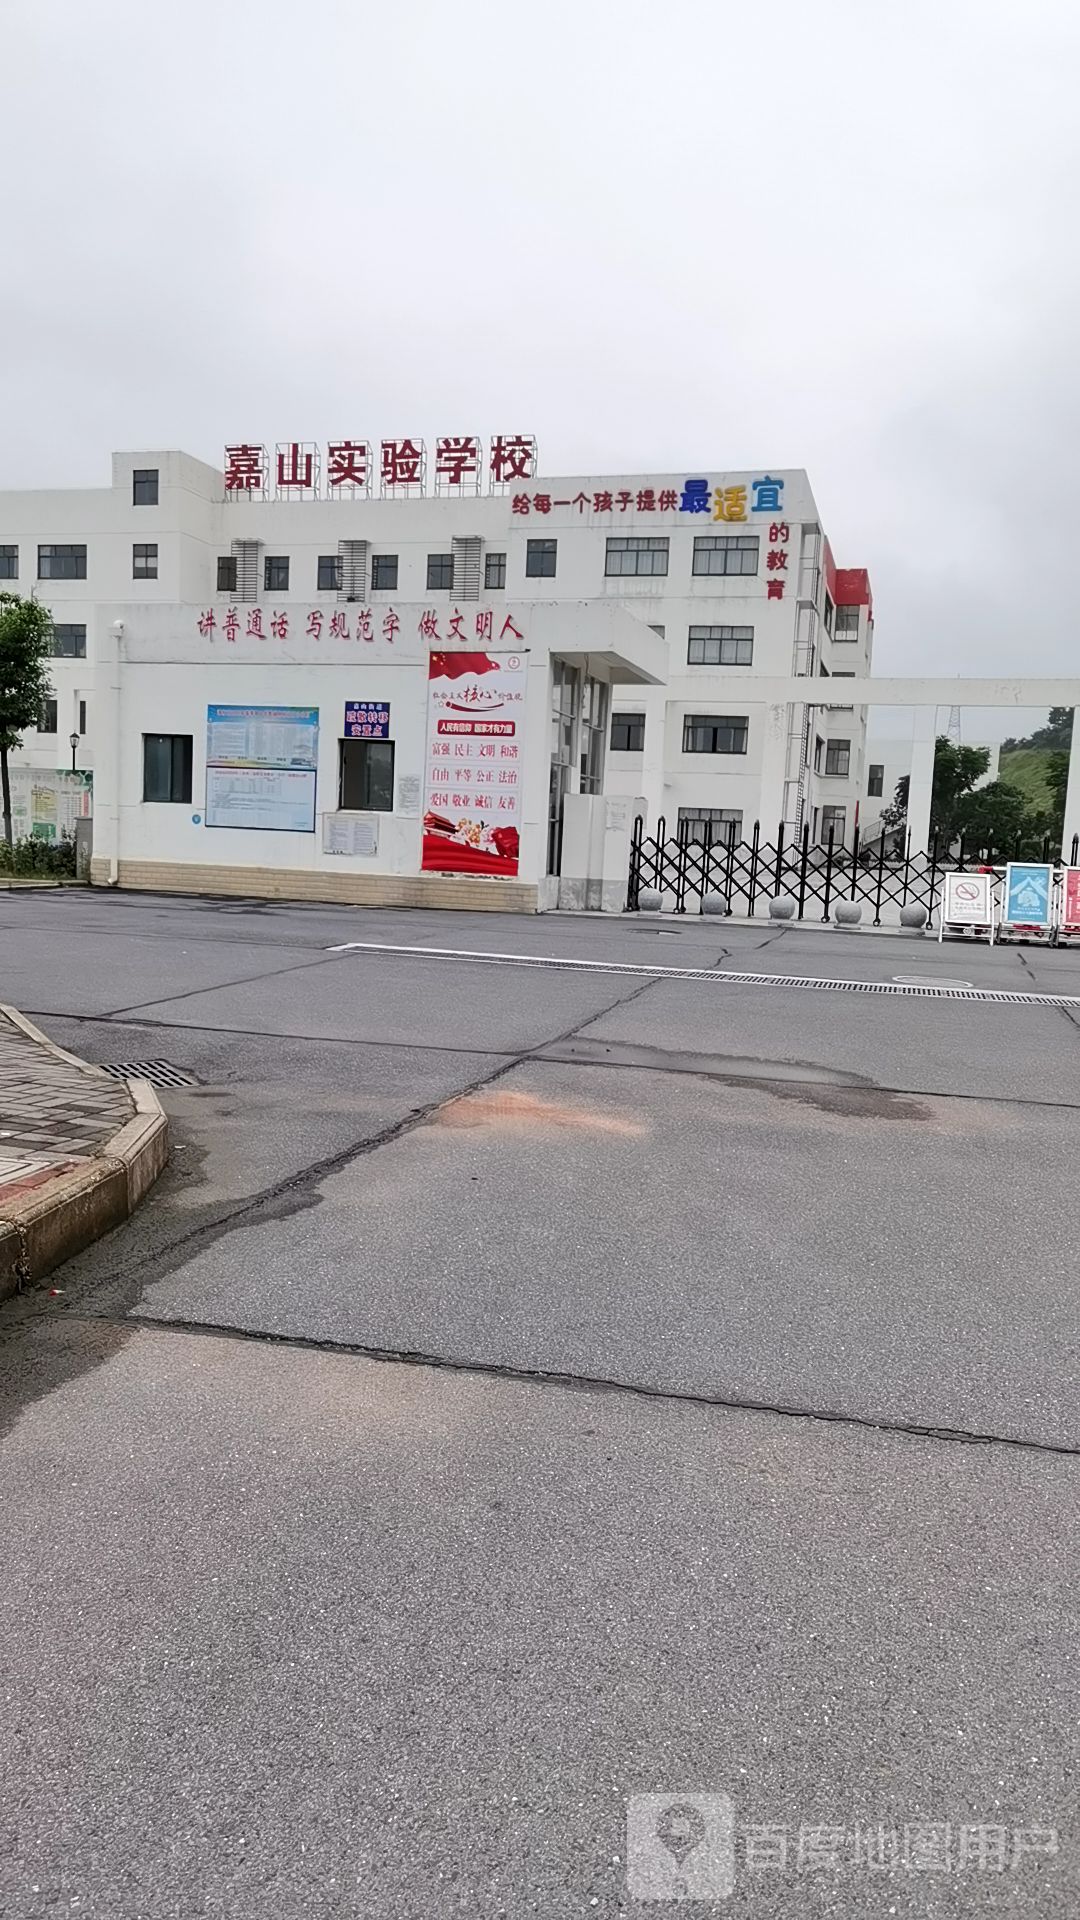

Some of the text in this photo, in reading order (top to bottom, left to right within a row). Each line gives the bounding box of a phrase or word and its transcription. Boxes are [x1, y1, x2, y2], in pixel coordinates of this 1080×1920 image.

[224, 435, 532, 490] 嘉山实验学校
[766, 522, 790, 600] 的教育
[197, 606, 524, 643] 讲普通话 写规范字 做文明人
[351, 724, 383, 736] 安置点
[432, 743, 519, 758] 富强 民主 文明 和谐
[432, 768, 517, 784] 自由 平等 公正 法治
[430, 793, 516, 809] 爱国 敬业 诚信 友善
